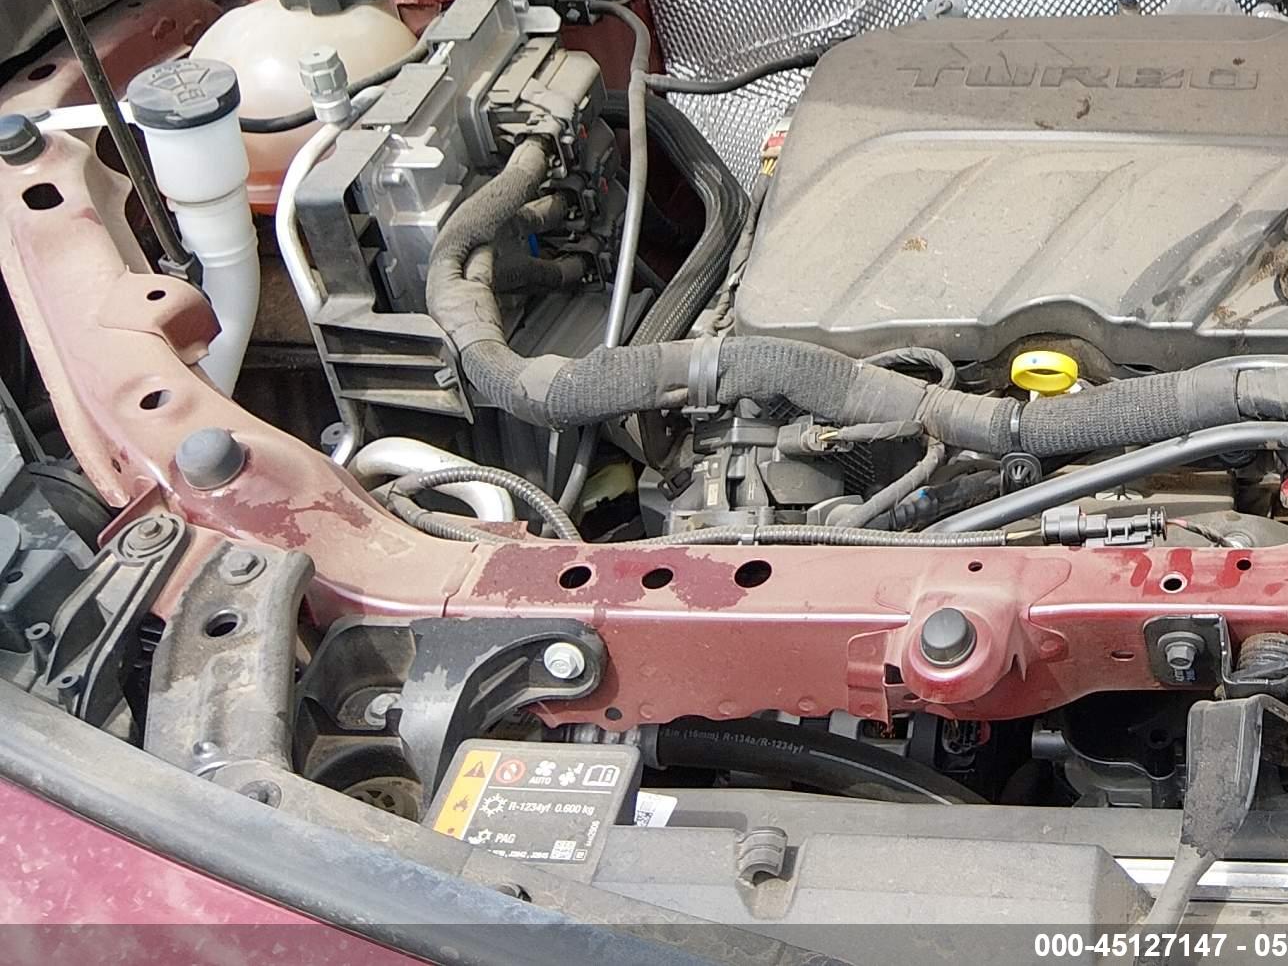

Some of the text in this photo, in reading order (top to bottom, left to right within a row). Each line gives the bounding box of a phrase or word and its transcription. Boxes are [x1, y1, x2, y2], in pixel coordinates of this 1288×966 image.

[896, 65, 1258, 91] TURBO
[722, 732, 804, 754] R-134a/R-1234yf
[529, 776, 552, 785] AUTO
[508, 801, 595, 816] R-1234yf 0.600 kg
[495, 833, 516, 844] PAG
